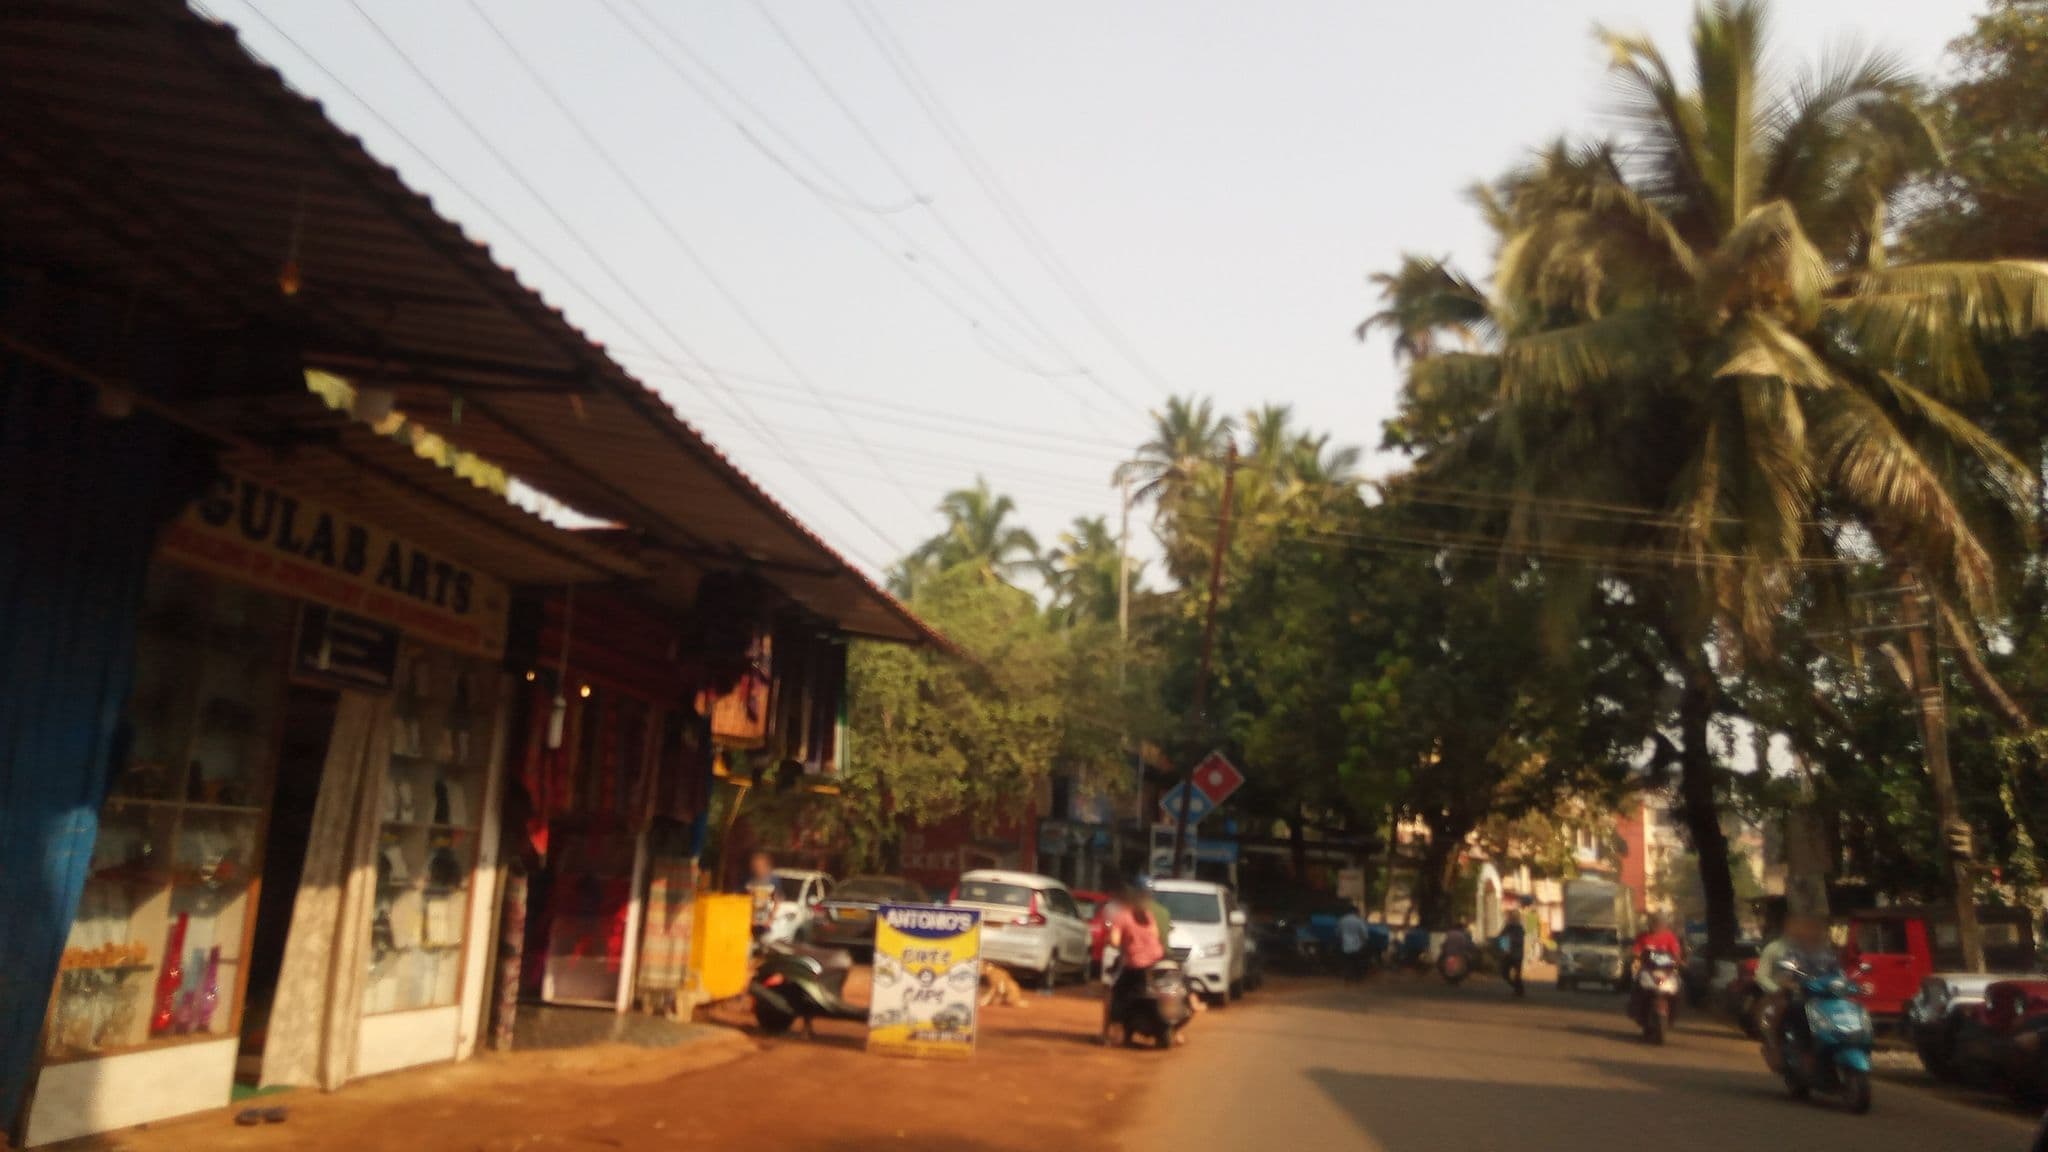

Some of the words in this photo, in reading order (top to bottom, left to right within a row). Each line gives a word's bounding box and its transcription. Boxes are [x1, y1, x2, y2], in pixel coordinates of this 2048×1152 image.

[201, 475, 367, 574] GULAB
[377, 541, 472, 613] ARTS
[887, 909, 971, 931] ANTONIO'S
